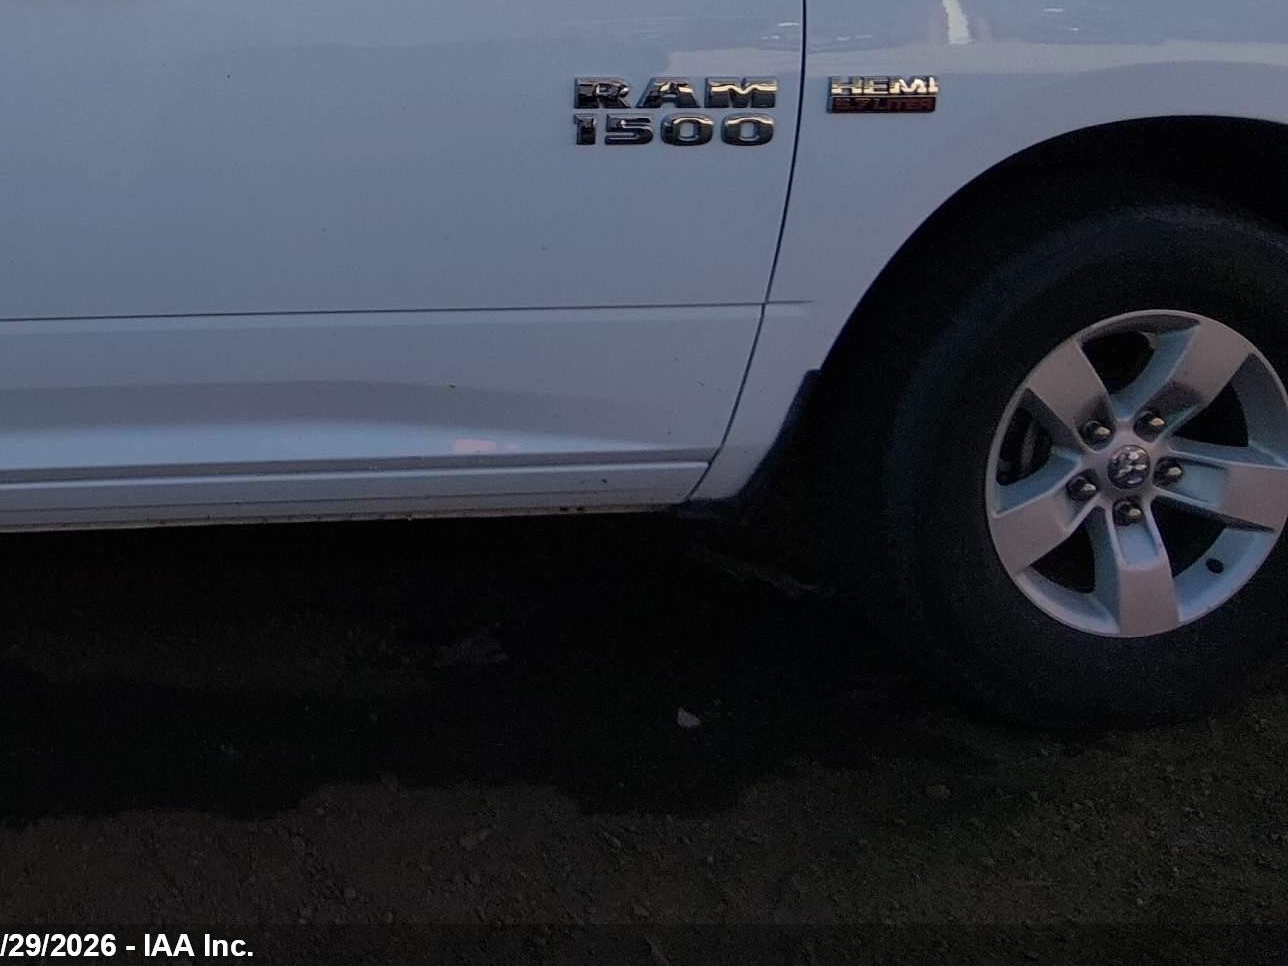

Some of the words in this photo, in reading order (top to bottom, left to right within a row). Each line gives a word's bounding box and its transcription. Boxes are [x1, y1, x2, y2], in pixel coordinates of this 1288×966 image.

[574, 76, 778, 109] RAM
[829, 76, 939, 94] HEMI
[575, 113, 775, 146] 1500
